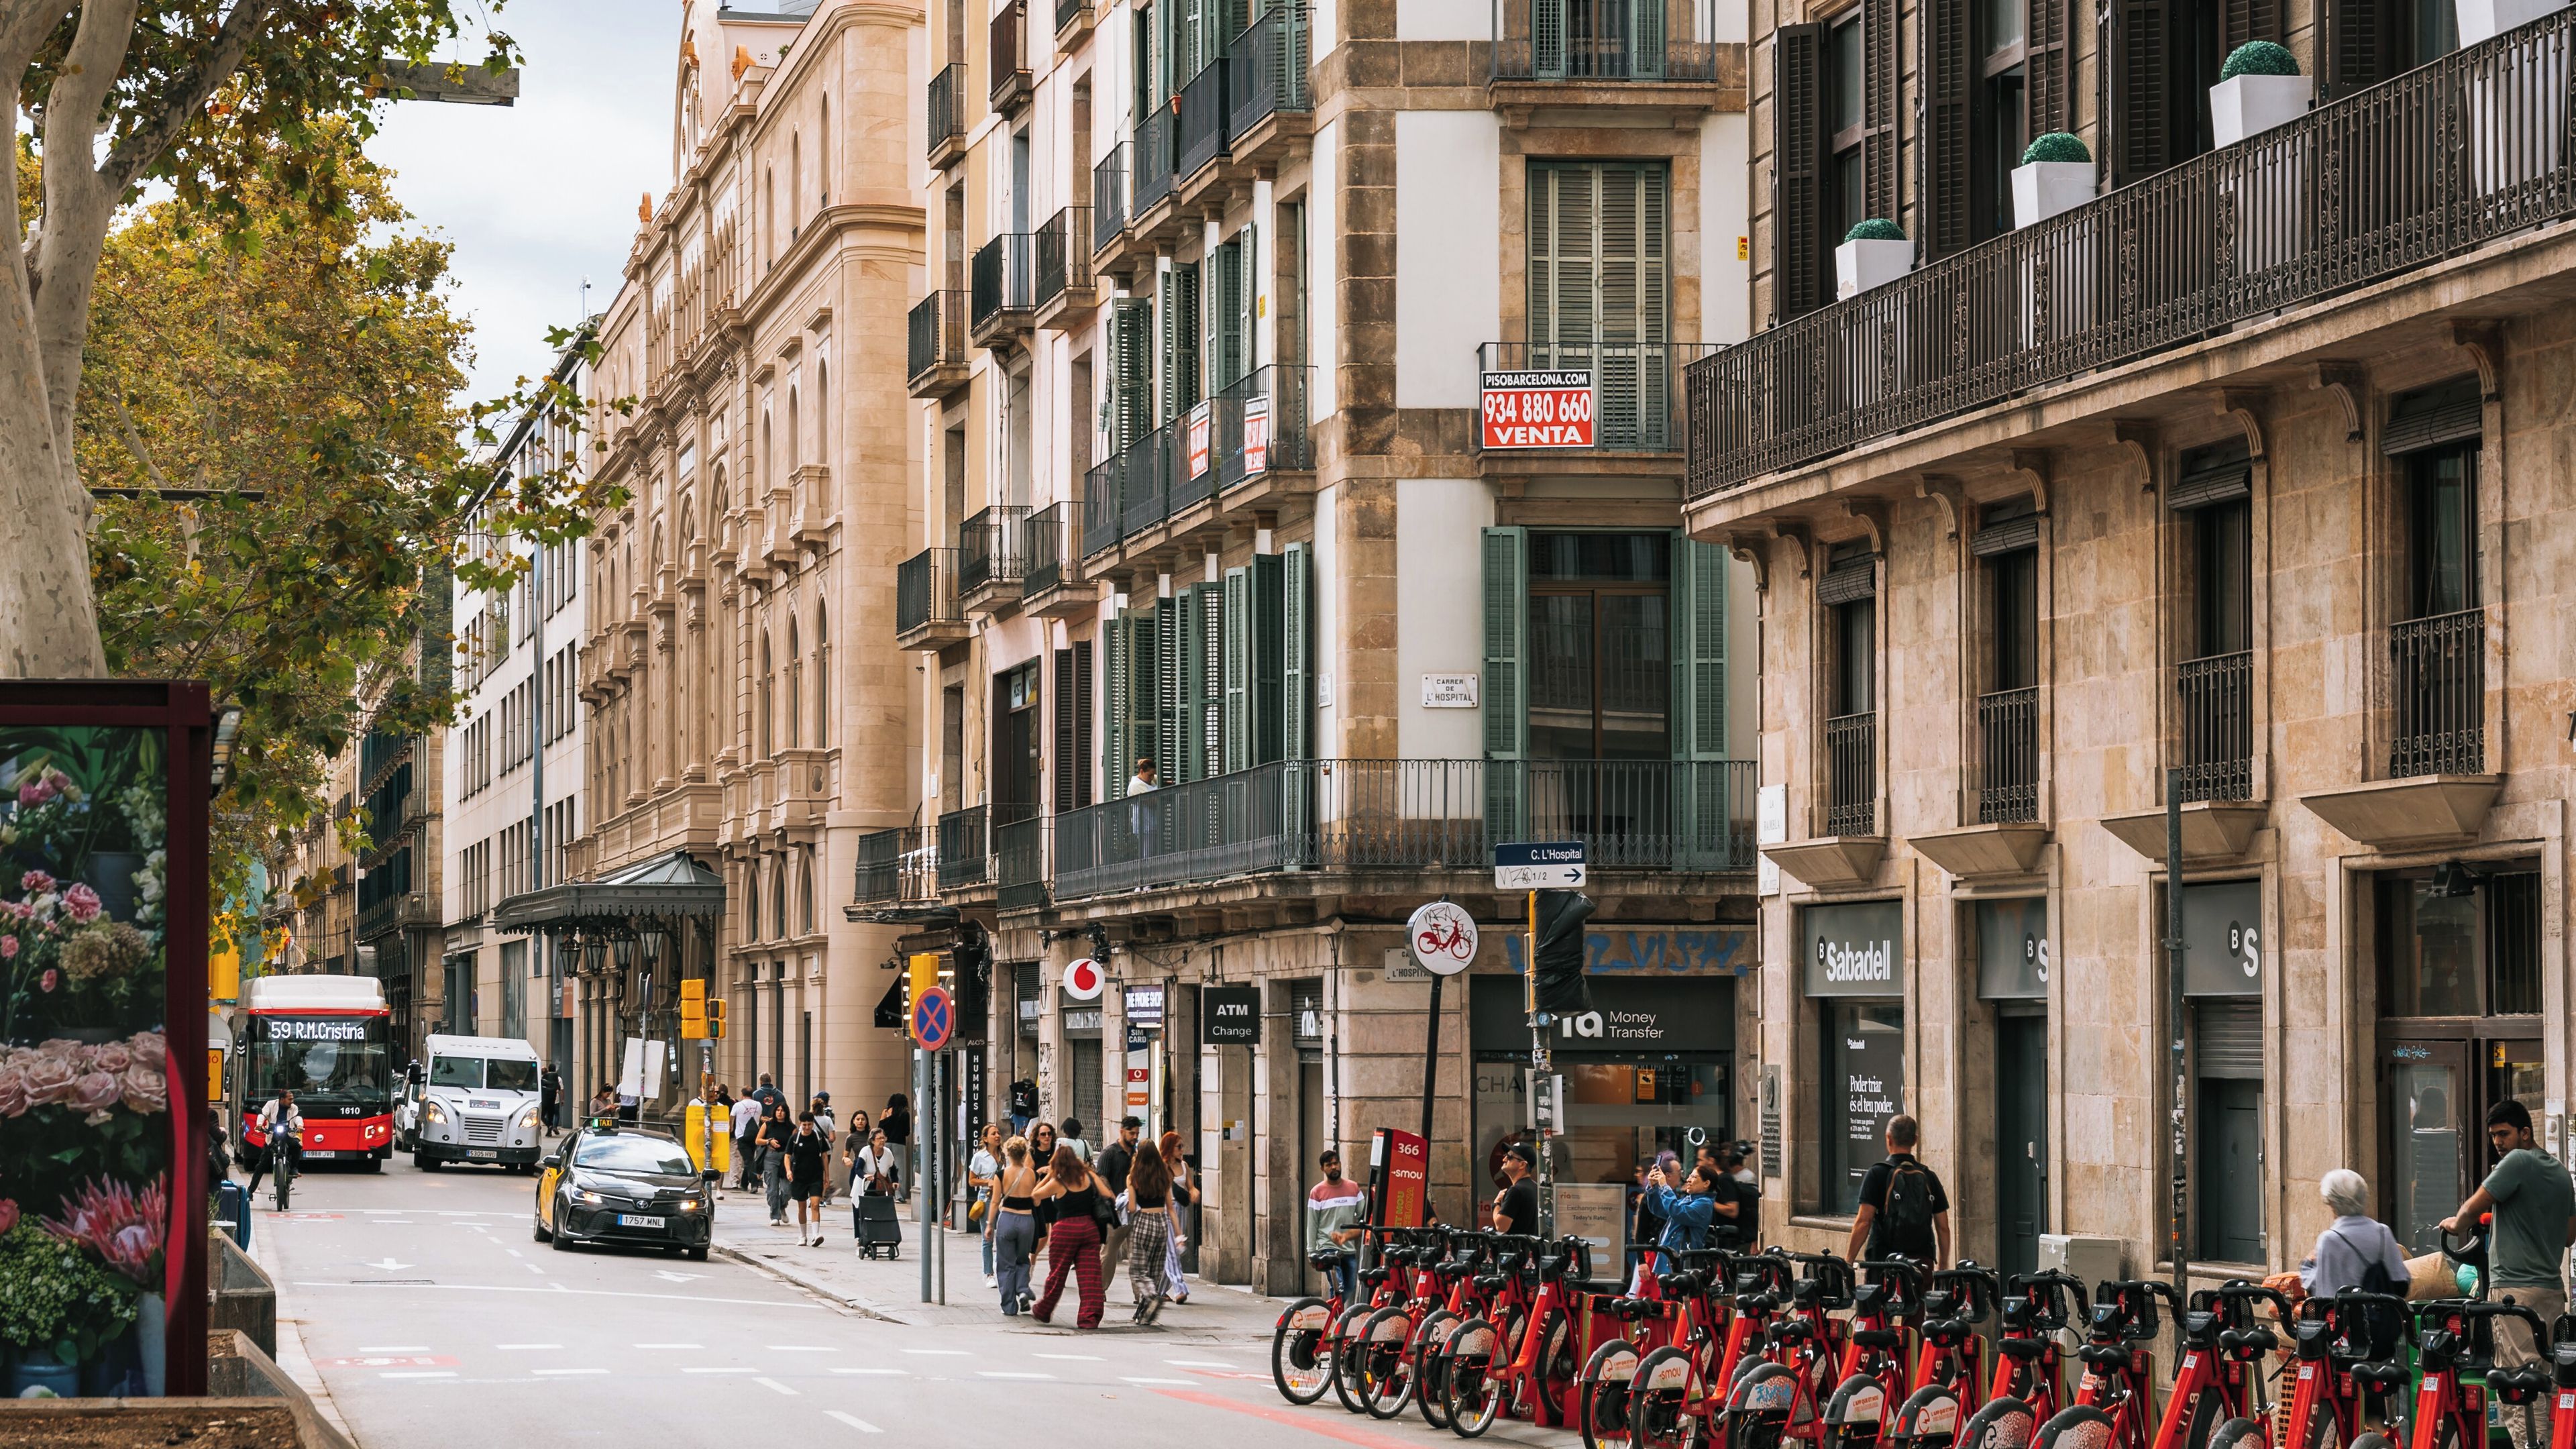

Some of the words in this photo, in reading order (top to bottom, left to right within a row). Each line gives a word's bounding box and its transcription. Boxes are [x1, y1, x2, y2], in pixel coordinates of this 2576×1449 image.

[1485, 373, 1588, 386] PISOBARCELONA.COM
[1485, 393, 1517, 423] 934
[1522, 392, 1554, 423] 880
[1558, 392, 1591, 423] 660
[1493, 425, 1583, 444] VENTA
[1531, 849, 1540, 860] C.
[1542, 848, 1582, 861] L'Hospital
[1826, 940, 1890, 982] Sabadell
[1392, 968, 1429, 977] L'HOSPITA
[1216, 1004, 1248, 1016] ATM
[1610, 1010, 1656, 1026] Money
[271, 1022, 291, 1039] 59
[296, 1022, 364, 1040] R.M.Cristina
[1212, 1026, 1252, 1038] Change
[1609, 1026, 1664, 1039] Transfer
[1850, 1074, 1868, 1093] Poder
[1868, 1075, 1882, 1093] triar
[1850, 1094, 1858, 1112] és
[1858, 1095, 1863, 1112] el
[1864, 1097, 1874, 1113] teu
[1874, 1095, 1894, 1118] poder.
[599, 1119, 612, 1127] TAXI
[1398, 1142, 1419, 1156] 366
[1395, 1169, 1423, 1180] smou
[625, 1216, 645, 1226] 1757
[647, 1218, 662, 1227] MNL
[1662, 1366, 1681, 1380] smou
